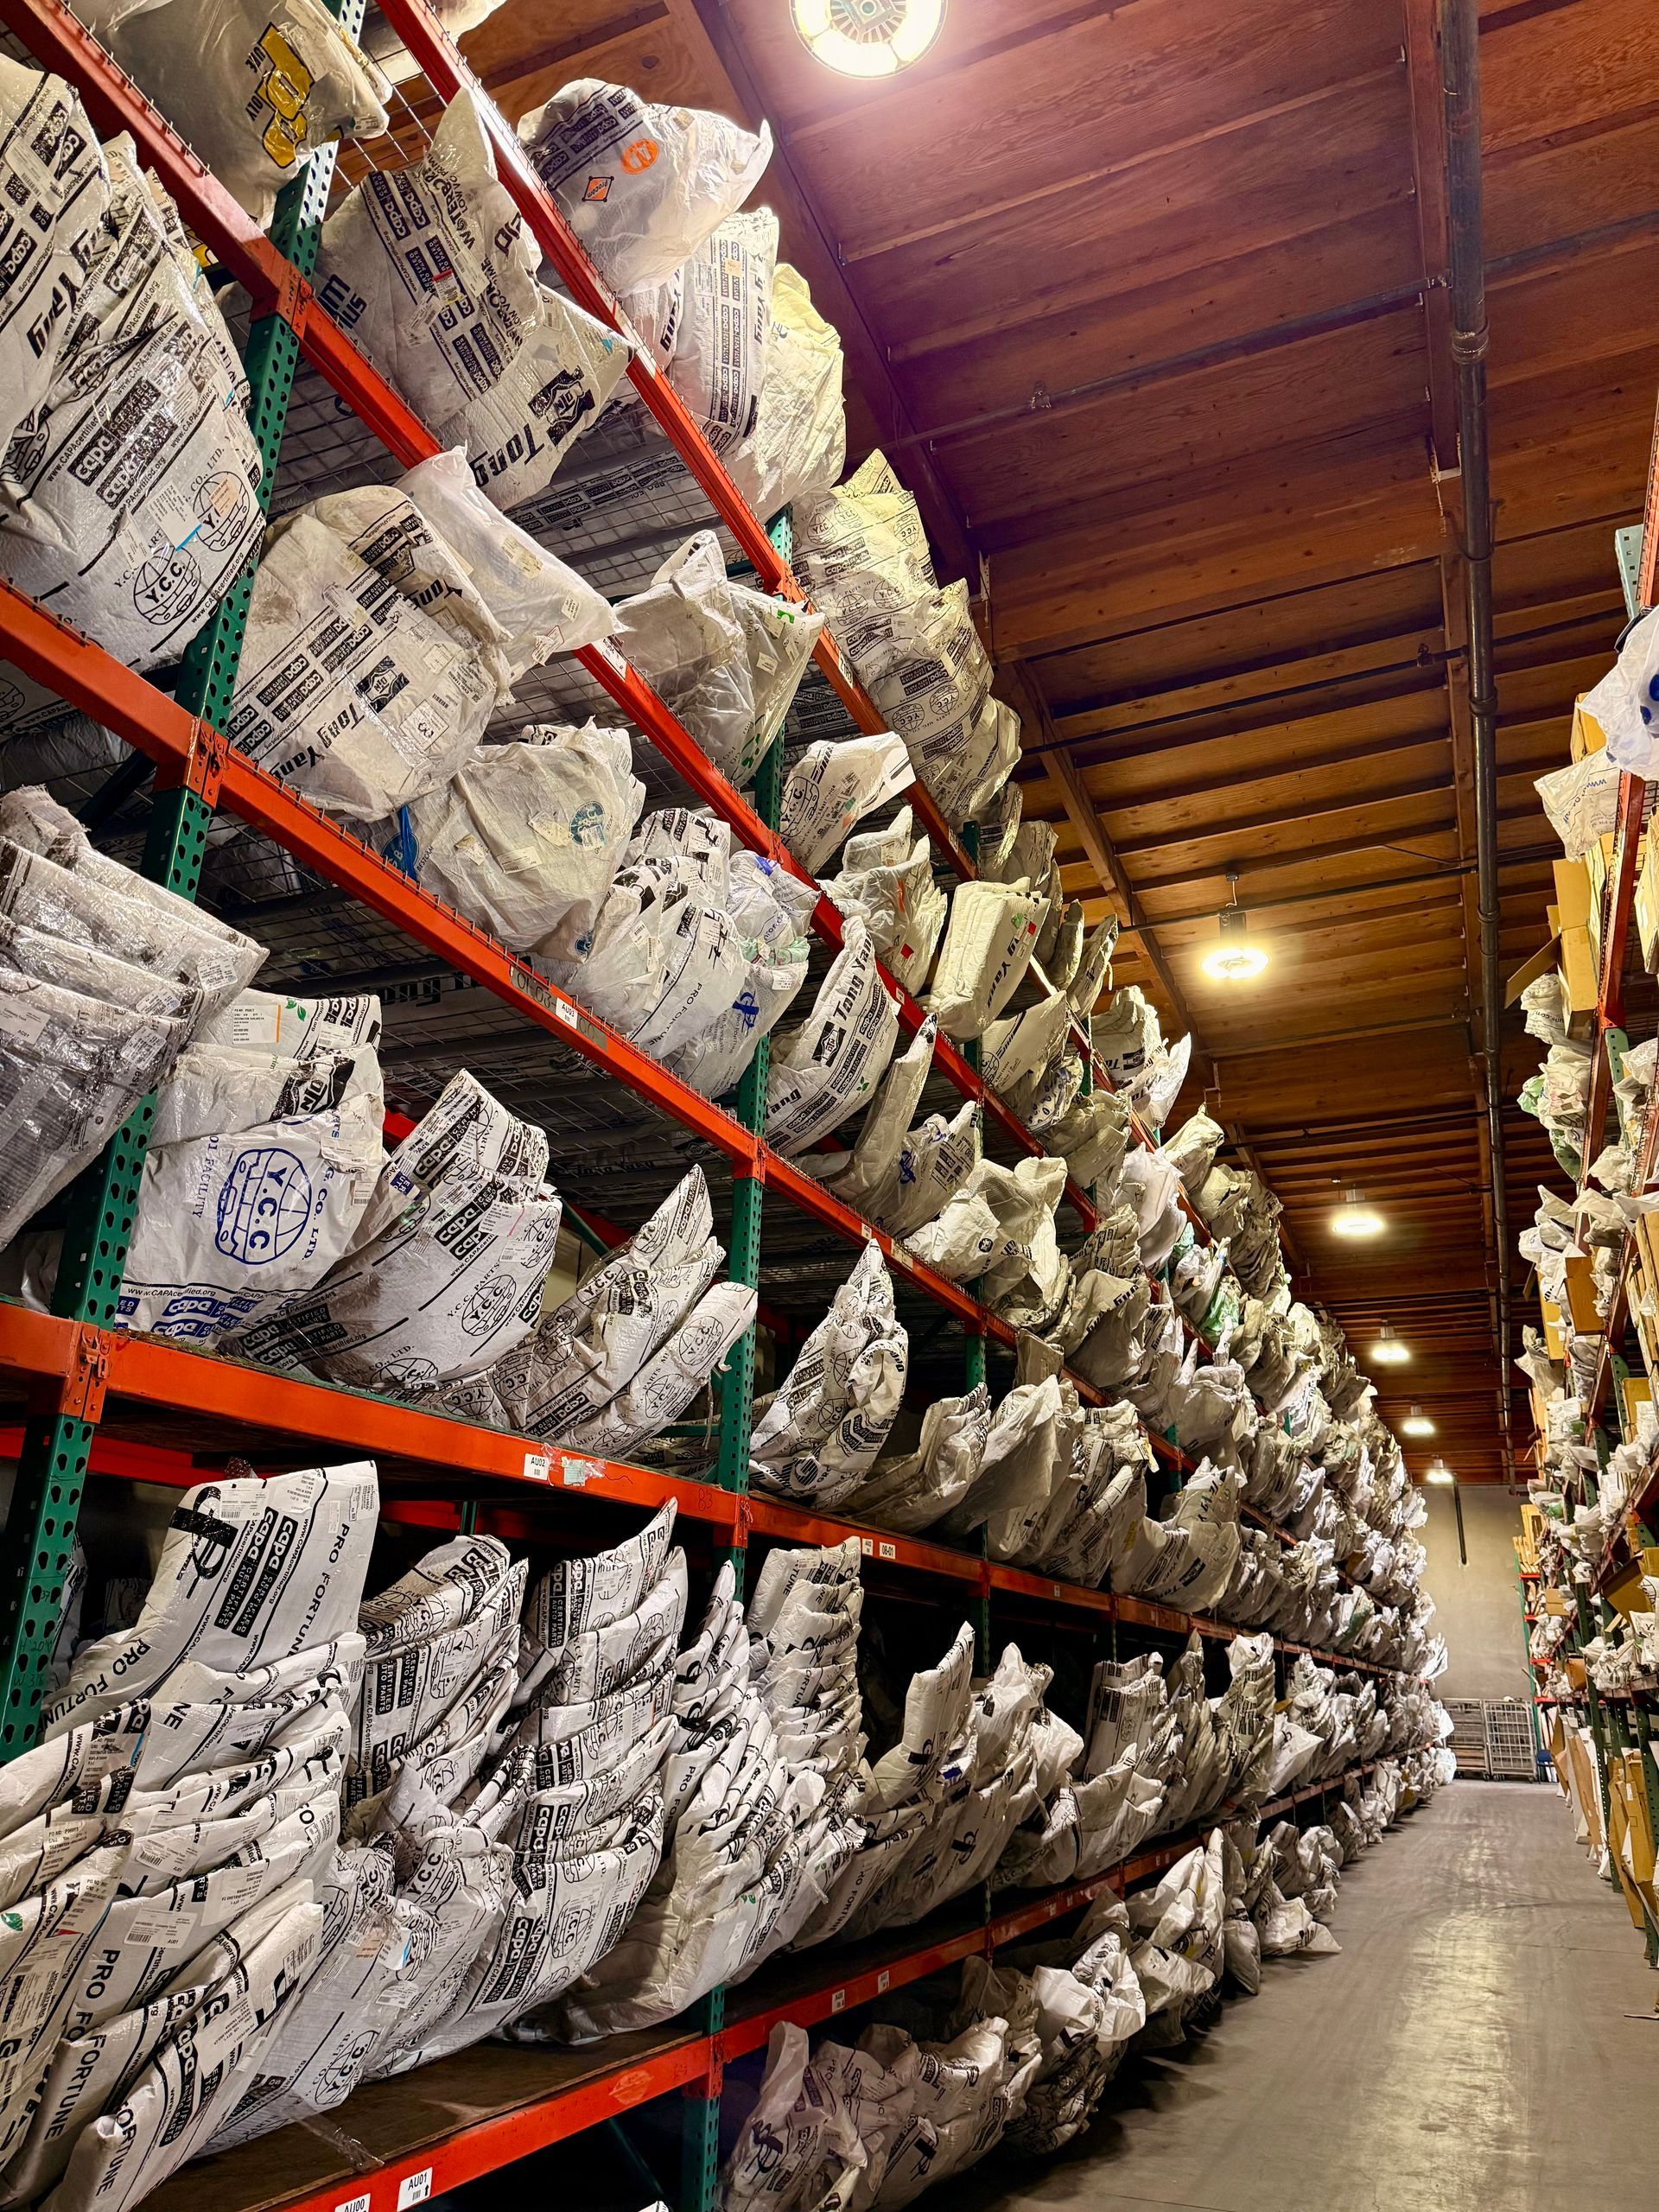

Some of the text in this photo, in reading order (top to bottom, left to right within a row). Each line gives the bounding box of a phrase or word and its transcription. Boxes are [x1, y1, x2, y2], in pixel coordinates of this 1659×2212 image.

[587, 180, 609, 199] procom
[385, 202, 407, 239] capa
[405, 194, 428, 227] capa
[116, 321, 179, 395] www.CAPAcertified.org
[207, 447, 225, 470] LTD.
[145, 562, 186, 605] Y.C.C.
[191, 551, 245, 623] www.CAPAcertified.org
[348, 626, 369, 648] capa
[285, 658, 307, 679] capa
[299, 673, 321, 695] capa
[232, 709, 255, 731] capa
[246, 722, 270, 747] capa
[686, 982, 703, 1006] PRO
[833, 976, 865, 1020] Tong
[561, 1004, 575, 1018] AU03
[860, 1012, 873, 1031] capa
[867, 1016, 880, 1037] capa
[832, 1067, 846, 1088] capa
[838, 1072, 853, 1093] capa
[787, 1112, 807, 1129] capa
[795, 1118, 813, 1133] capa
[478, 1124, 494, 1157] PARTS
[416, 1137, 452, 1176] capa
[193, 1156, 213, 1219] FACILITY
[439, 1207, 476, 1243] capa
[302, 1227, 319, 1261] LTD.
[454, 1230, 483, 1257] cap
[447, 1262, 500, 1318] Y.C.C. PARTS
[583, 1269, 618, 1297] Y.C.C.
[168, 1298, 210, 1314] capa
[469, 1285, 506, 1322] Y.C.C.
[152, 1320, 196, 1337] capa
[243, 1324, 279, 1348] capa
[688, 1325, 714, 1356] Y.C.C.
[260, 1342, 297, 1364] capa
[391, 1344, 415, 1358] LTD.
[642, 1367, 664, 1391] PARTS
[556, 1395, 586, 1418] capa
[575, 1434, 597, 1446] MFG.
[530, 1456, 546, 1468] AU02
[247, 1508, 275, 1560] capa
[266, 1520, 295, 1570] capa
[328, 1523, 350, 1565] PRO
[268, 1518, 309, 1605] www.CAPAcertified.org
[218, 1564, 248, 1625] AUTO PARTS
[224, 1567, 253, 1625] CERTIFIED
[235, 1573, 269, 1632] AUTO PARTS
[241, 1576, 273, 1632] CERTIFIED
[112, 1638, 152, 1676] PRO
[406, 1652, 416, 1704] CERTIFIED
[572, 1667, 582, 1696] PARTS
[378, 1683, 387, 1712] PARTS
[400, 1681, 409, 1707] PARTS
[678, 1765, 696, 1793] PRO
[532, 1806, 551, 1852] capa
[405, 1849, 445, 1894] Y.C.C.
[511, 1920, 529, 1961] capa
[86, 1948, 122, 1999] PRO
[327, 2042, 368, 2094] Y.C.C.
[44, 2034, 106, 2140] FORTUNE
[408, 2172, 428, 2191] AU01
[344, 2198, 365, 2212] AU00
